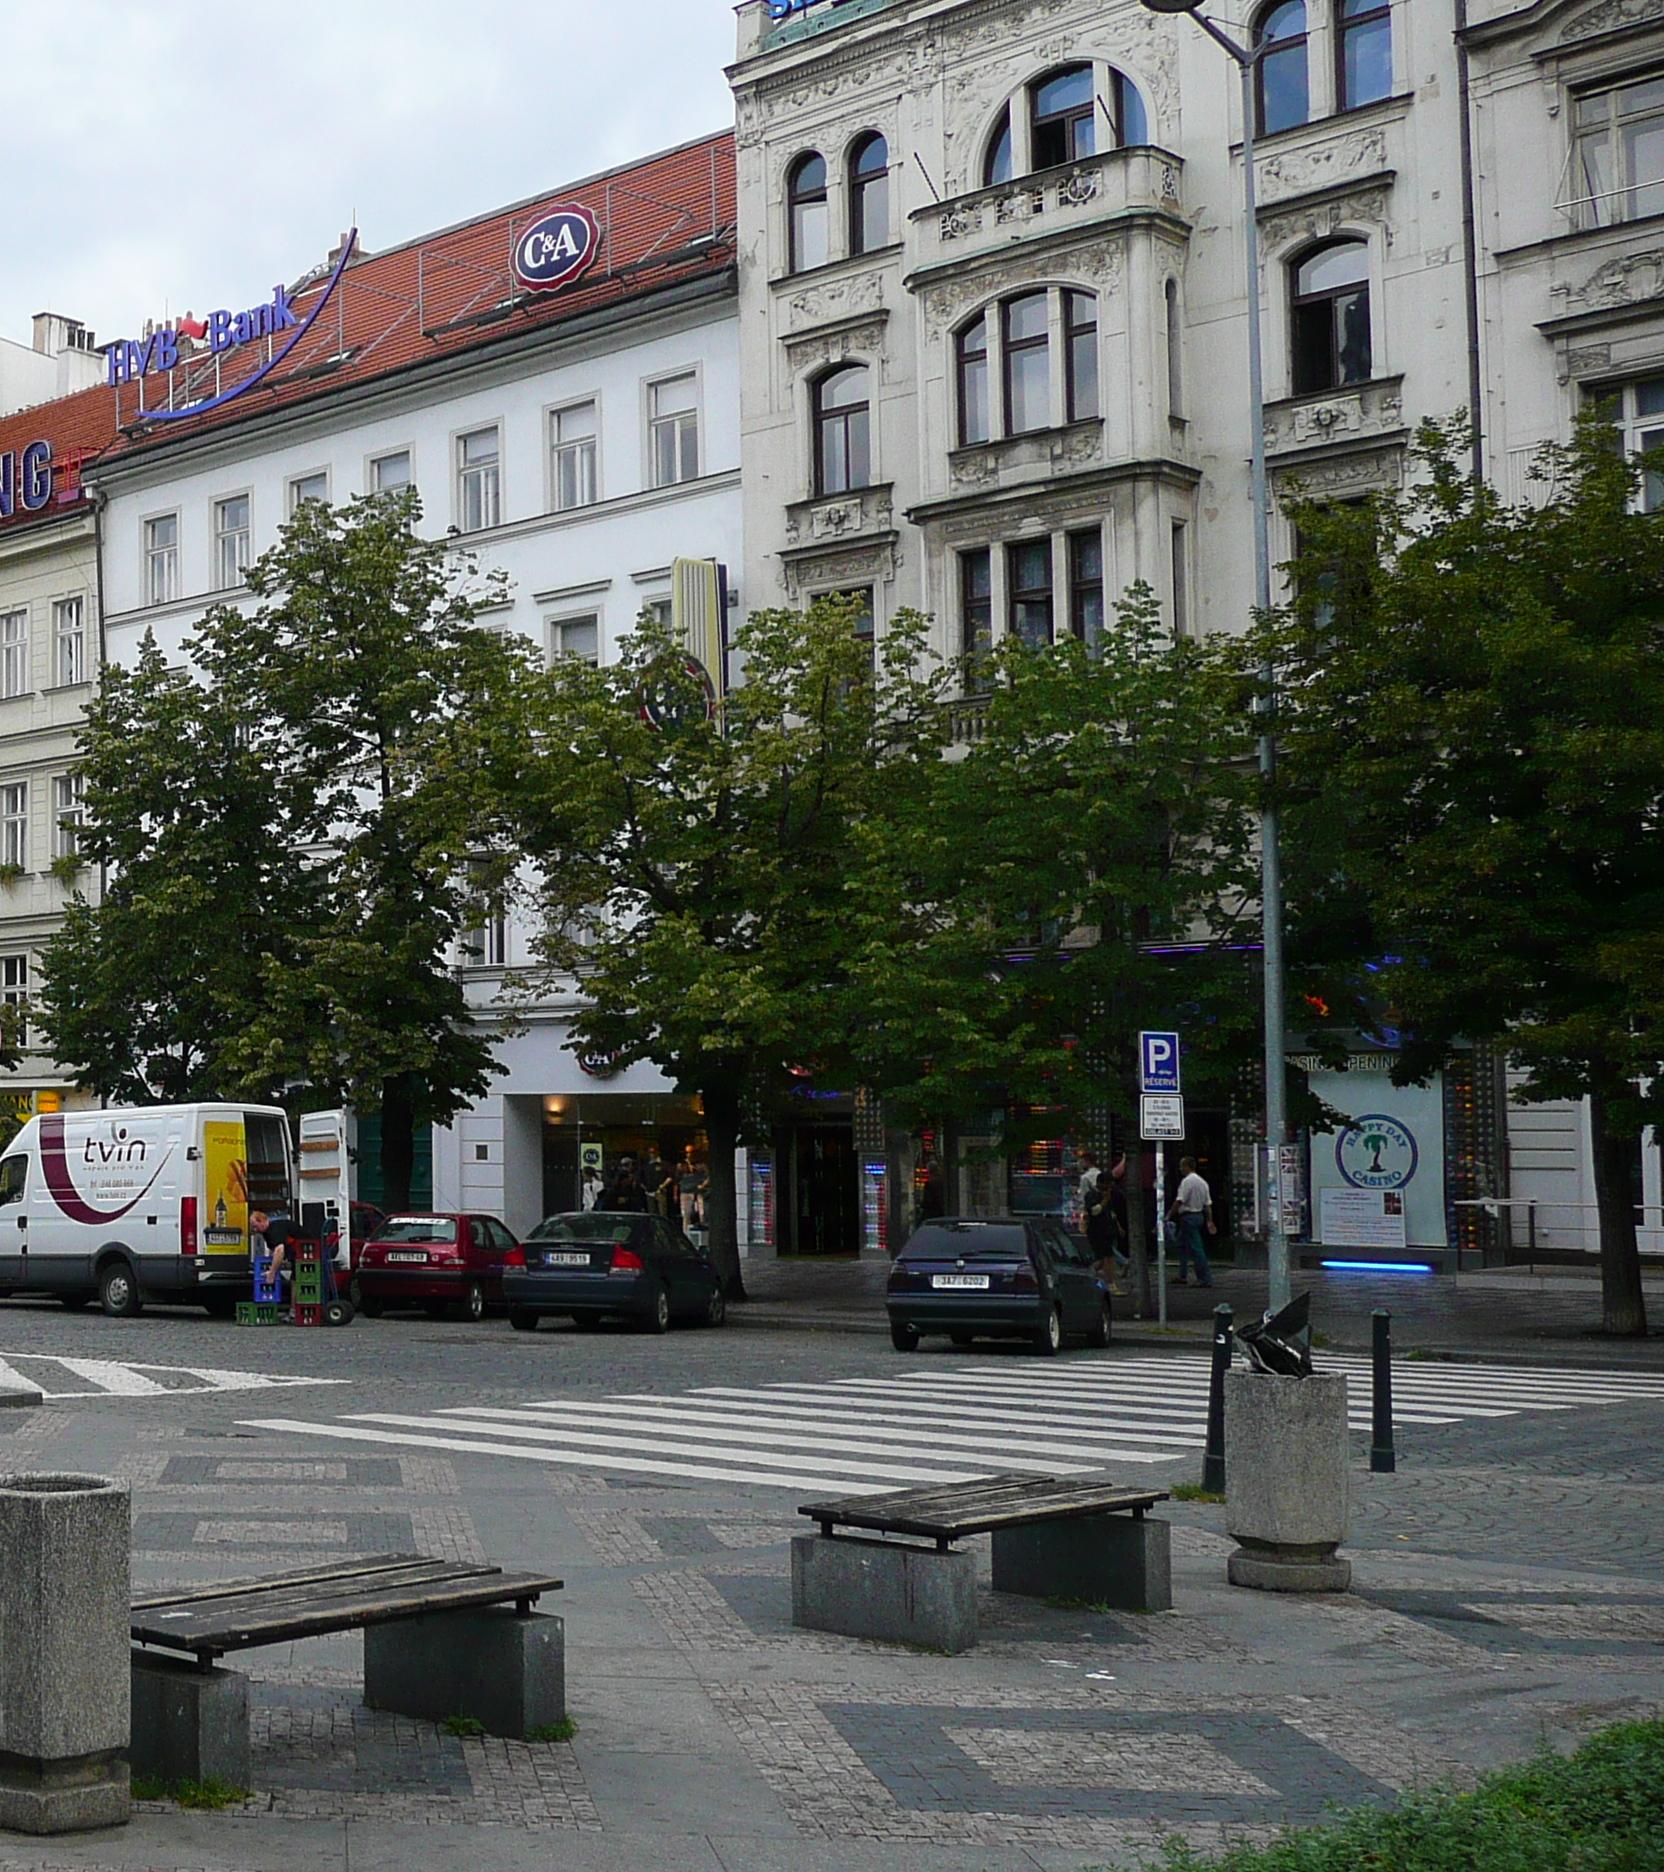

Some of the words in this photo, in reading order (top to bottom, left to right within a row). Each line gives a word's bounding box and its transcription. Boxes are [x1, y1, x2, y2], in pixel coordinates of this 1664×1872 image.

[524, 223, 580, 268] C&A
[107, 328, 178, 387] HVB
[208, 284, 297, 353] Bank
[1149, 1039, 1171, 1074] P
[84, 1130, 146, 1163] tvin
[1386, 1125, 1408, 1149] DAY
[1352, 1170, 1403, 1187] CASINO
[963, 1275, 986, 1286] 6202
